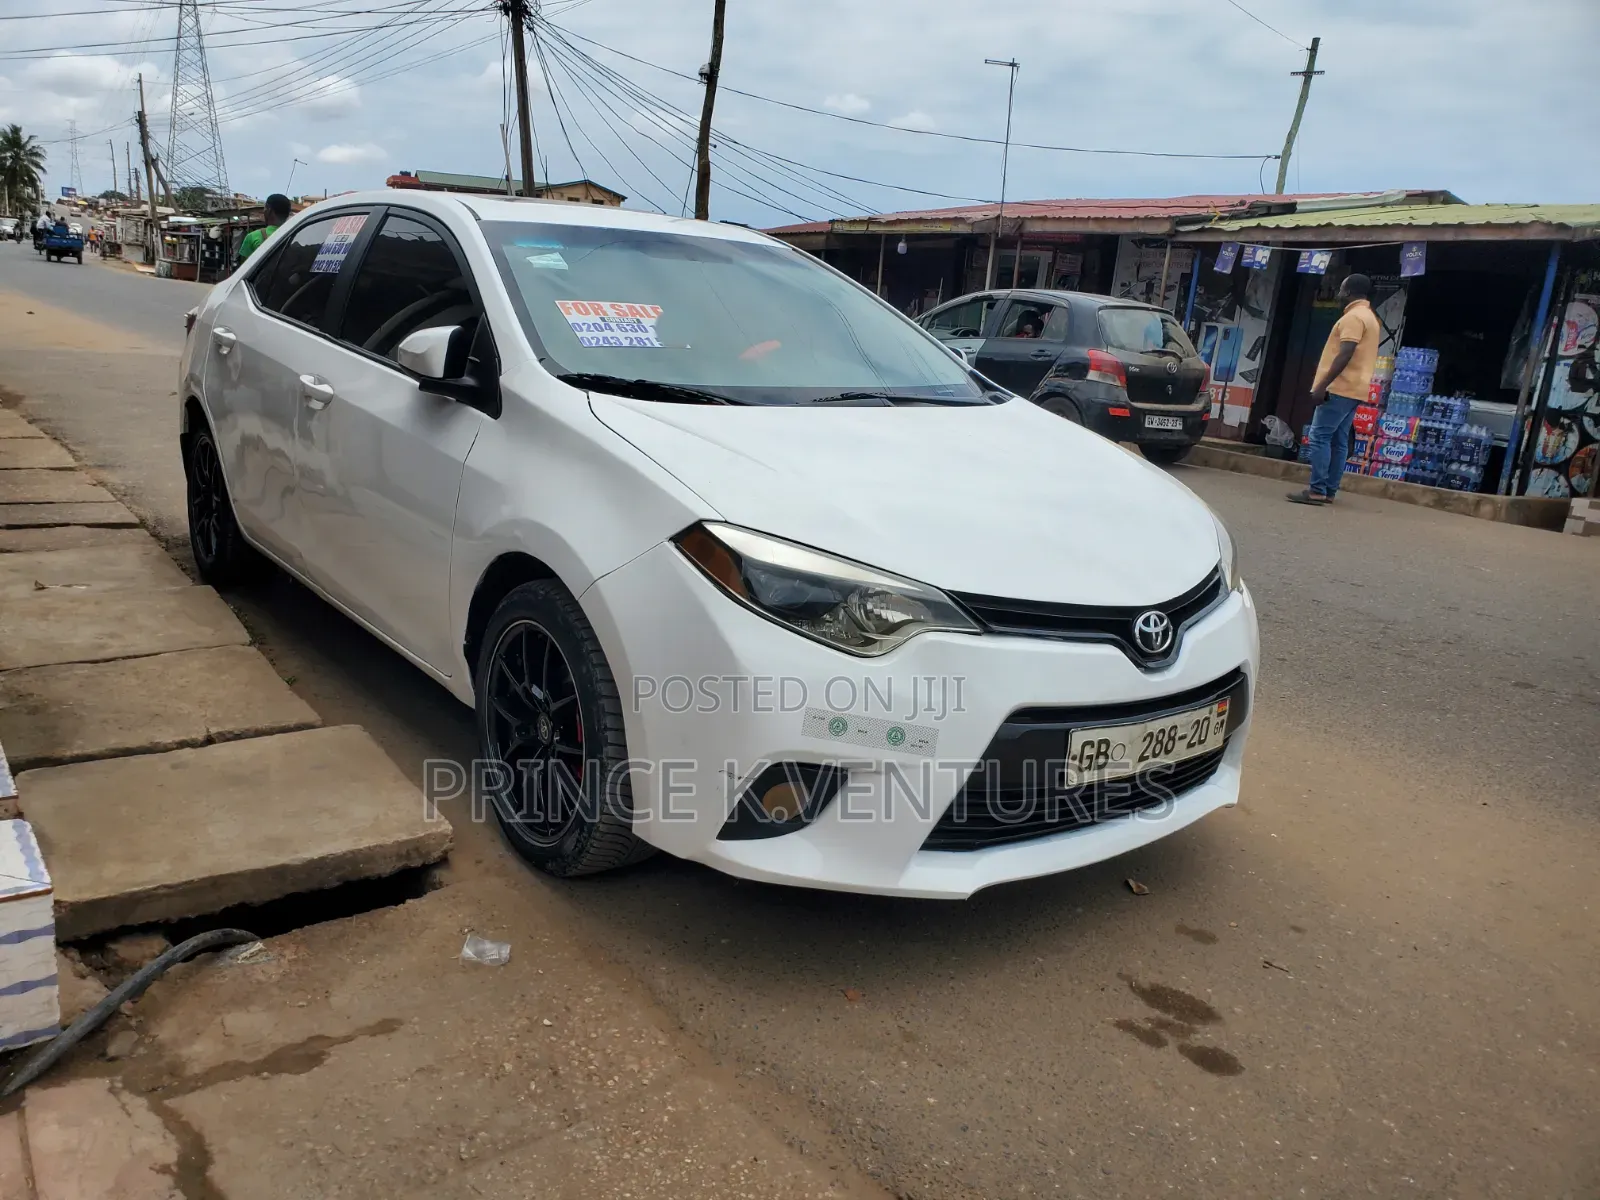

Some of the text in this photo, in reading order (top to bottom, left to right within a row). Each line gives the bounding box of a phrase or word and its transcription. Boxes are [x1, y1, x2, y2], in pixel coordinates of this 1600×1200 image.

[557, 302, 609, 316] FOR
[570, 322, 615, 333] 0204
[615, 323, 649, 334] 630
[580, 336, 624, 347] 0243
[1384, 423, 1403, 434] Verna
[1386, 447, 1405, 458] Verna
[1381, 471, 1399, 480] Verna
[1078, 738, 1111, 773] GB
[1138, 716, 1211, 763] 288-20
